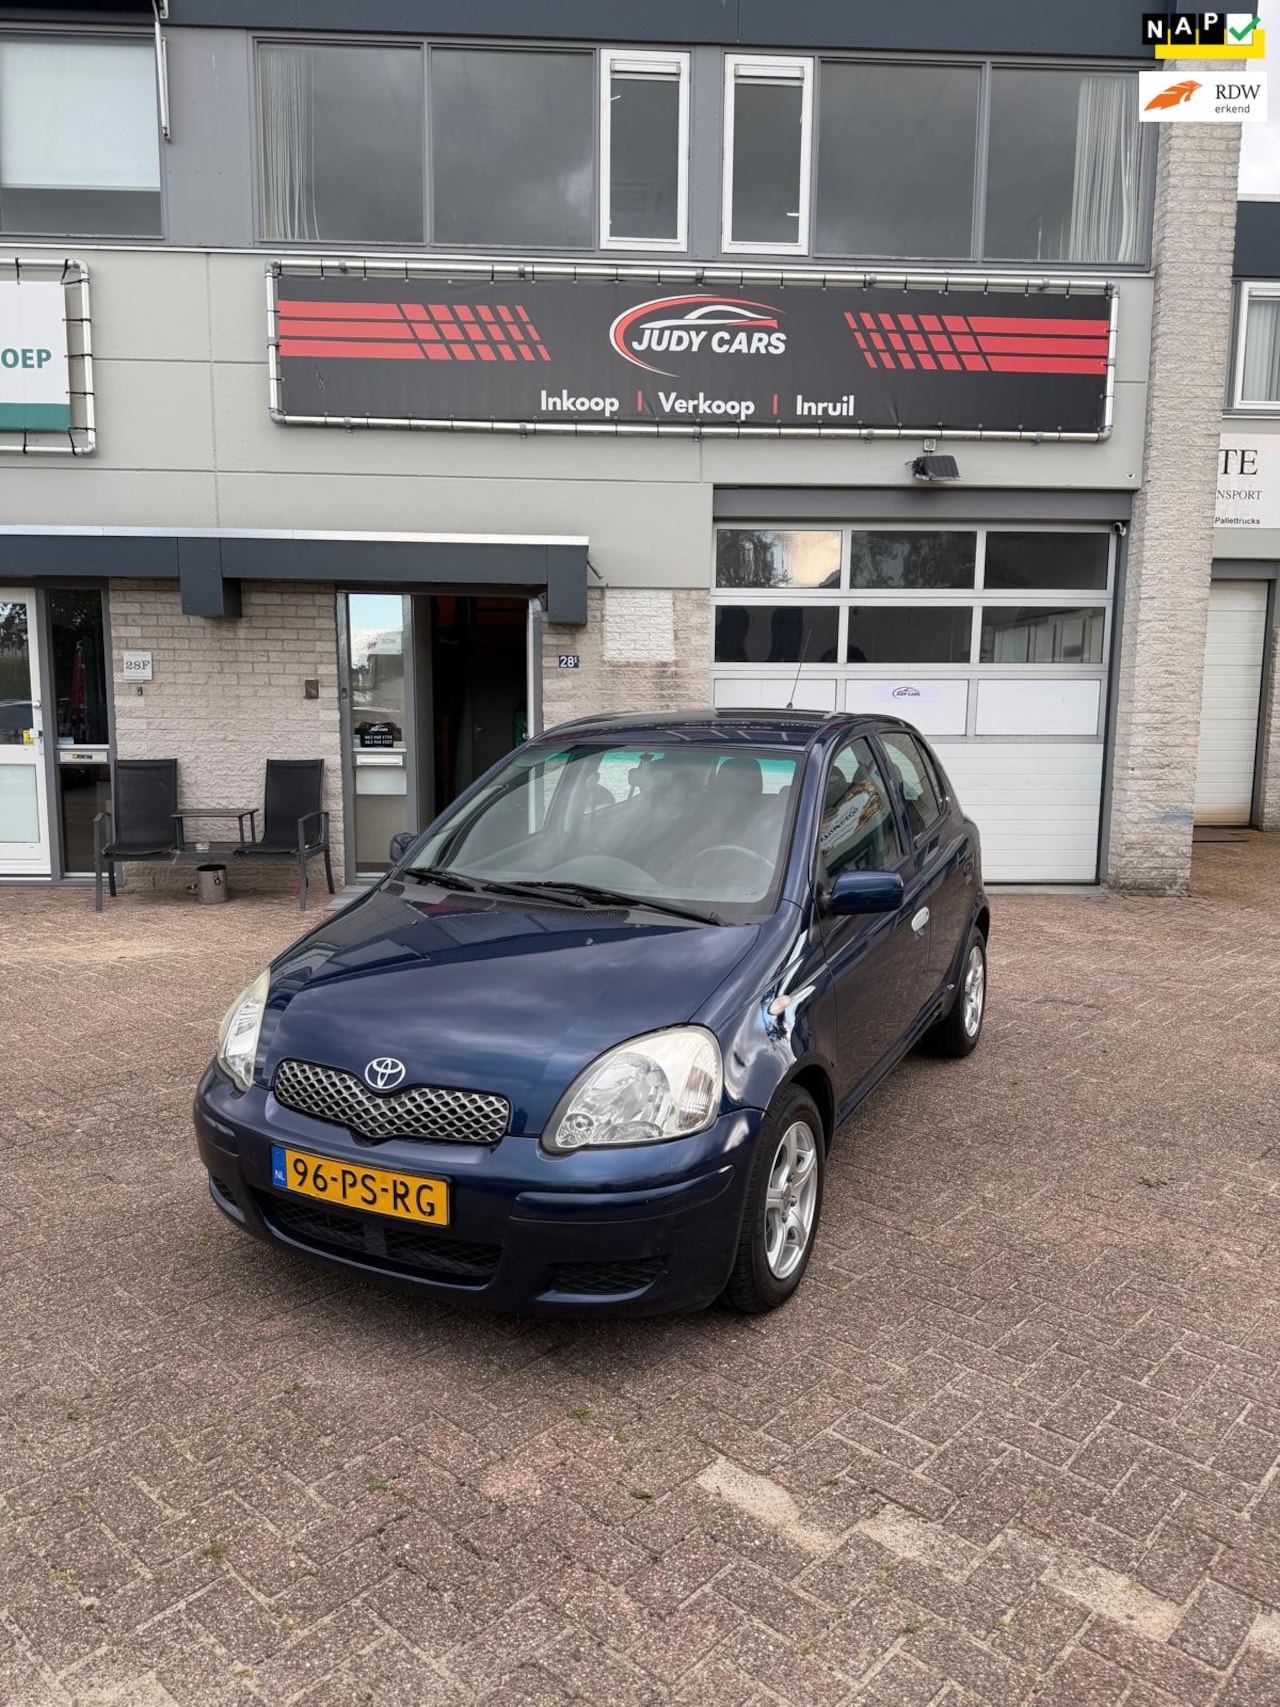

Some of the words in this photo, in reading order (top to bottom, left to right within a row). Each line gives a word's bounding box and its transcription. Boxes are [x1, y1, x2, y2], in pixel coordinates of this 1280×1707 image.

[632, 328, 708, 352] JUDY
[711, 331, 787, 355] CARS
[0, 348, 52, 369] OEP
[540, 389, 620, 417] Inkoop
[658, 391, 755, 421] Verkoop
[796, 394, 855, 417] Inruil
[1218, 449, 1258, 475] TE
[125, 660, 150, 670] 28F
[274, 1169, 286, 1181] NL
[292, 1157, 436, 1217] 96-PS-RG
